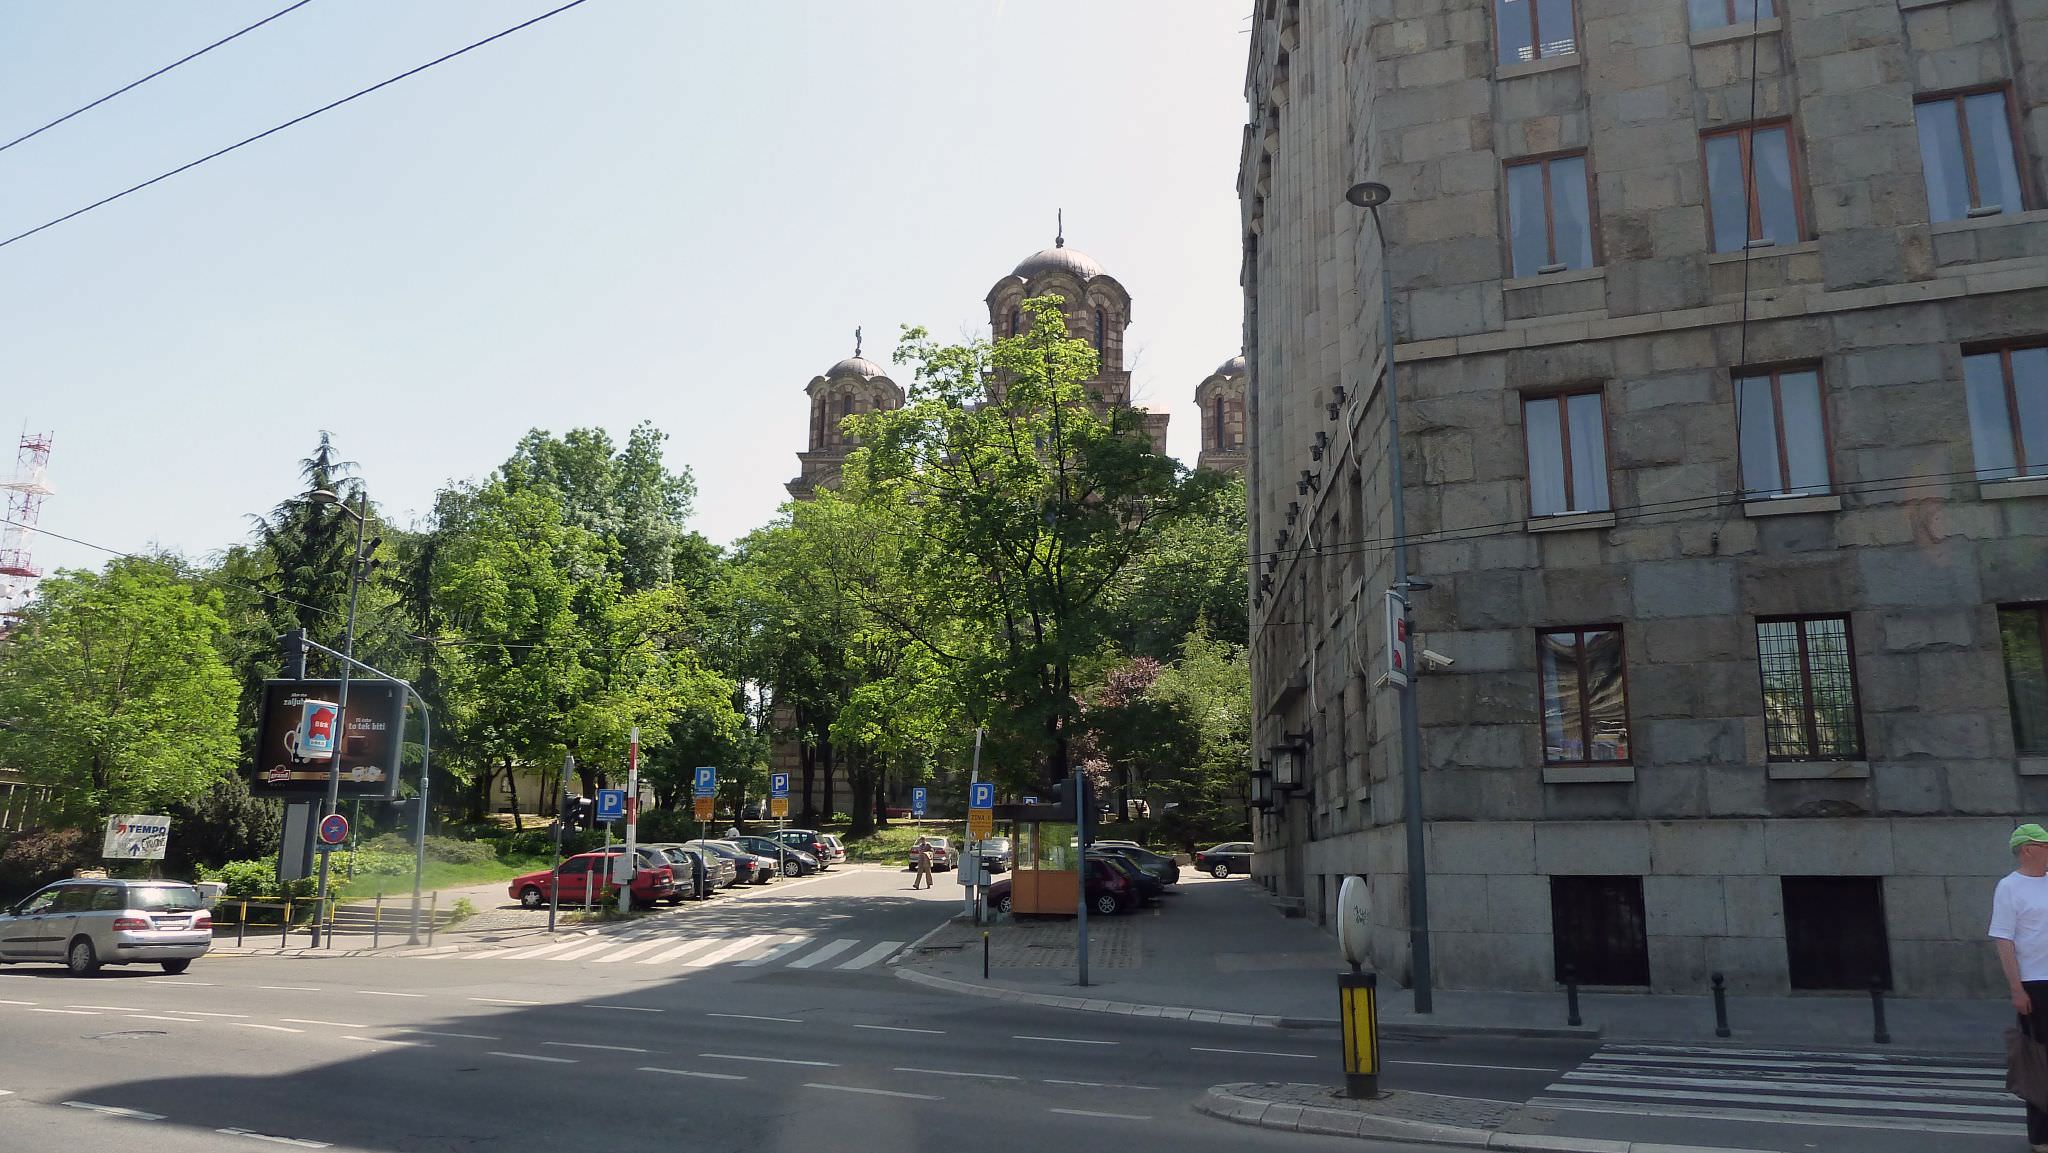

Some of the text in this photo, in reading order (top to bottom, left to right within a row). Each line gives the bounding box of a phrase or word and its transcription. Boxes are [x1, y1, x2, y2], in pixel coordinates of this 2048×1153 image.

[348, 722, 357, 730] to
[700, 770, 711, 786] P
[775, 776, 785, 790] P
[915, 790, 924, 800] P
[977, 786, 989, 805] P
[604, 794, 618, 811] P
[128, 824, 167, 834] TEMPO
